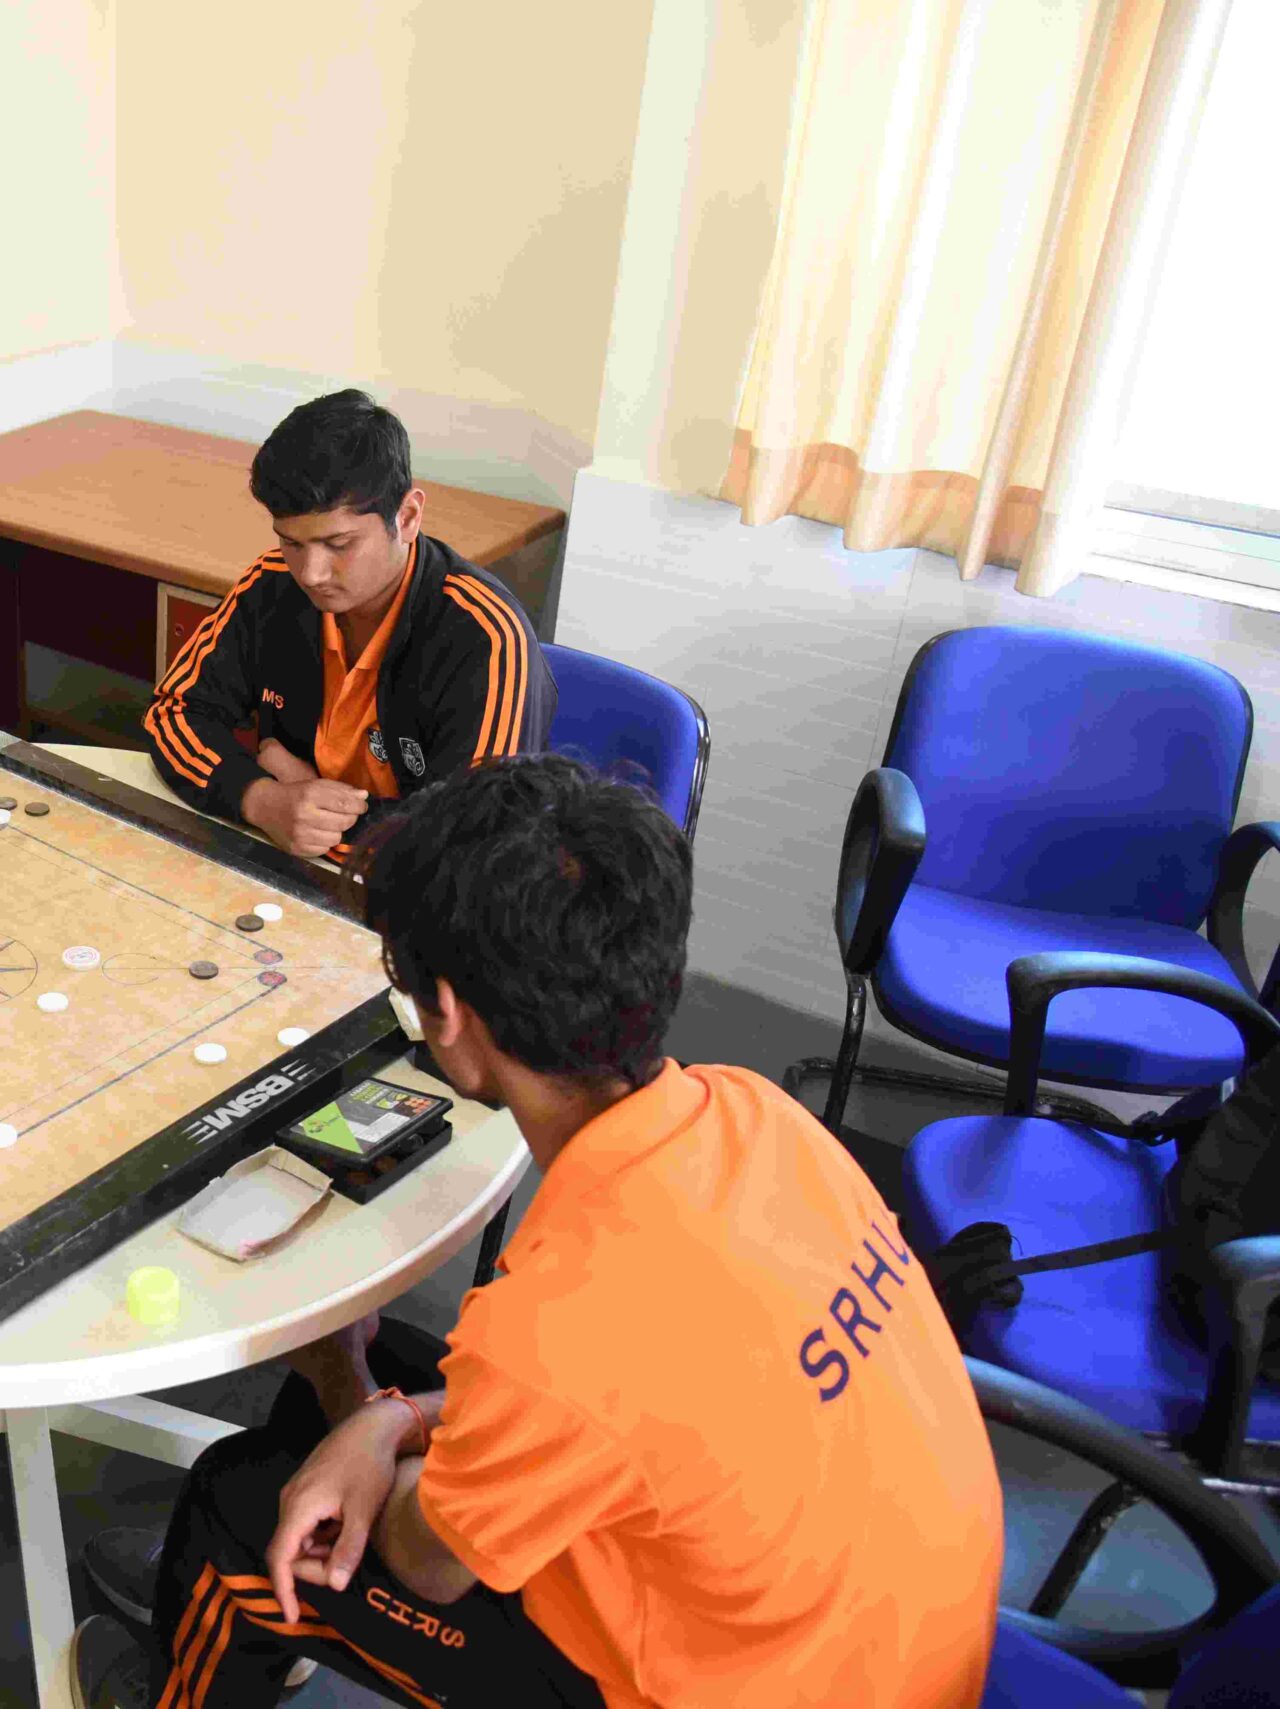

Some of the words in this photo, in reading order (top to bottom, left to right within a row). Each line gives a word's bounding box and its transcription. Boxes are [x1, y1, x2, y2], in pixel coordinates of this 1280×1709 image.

[202, 1074, 295, 1130] BSM
[799, 1208, 910, 1403] SRHU
[365, 1586, 466, 1649] SRHU
